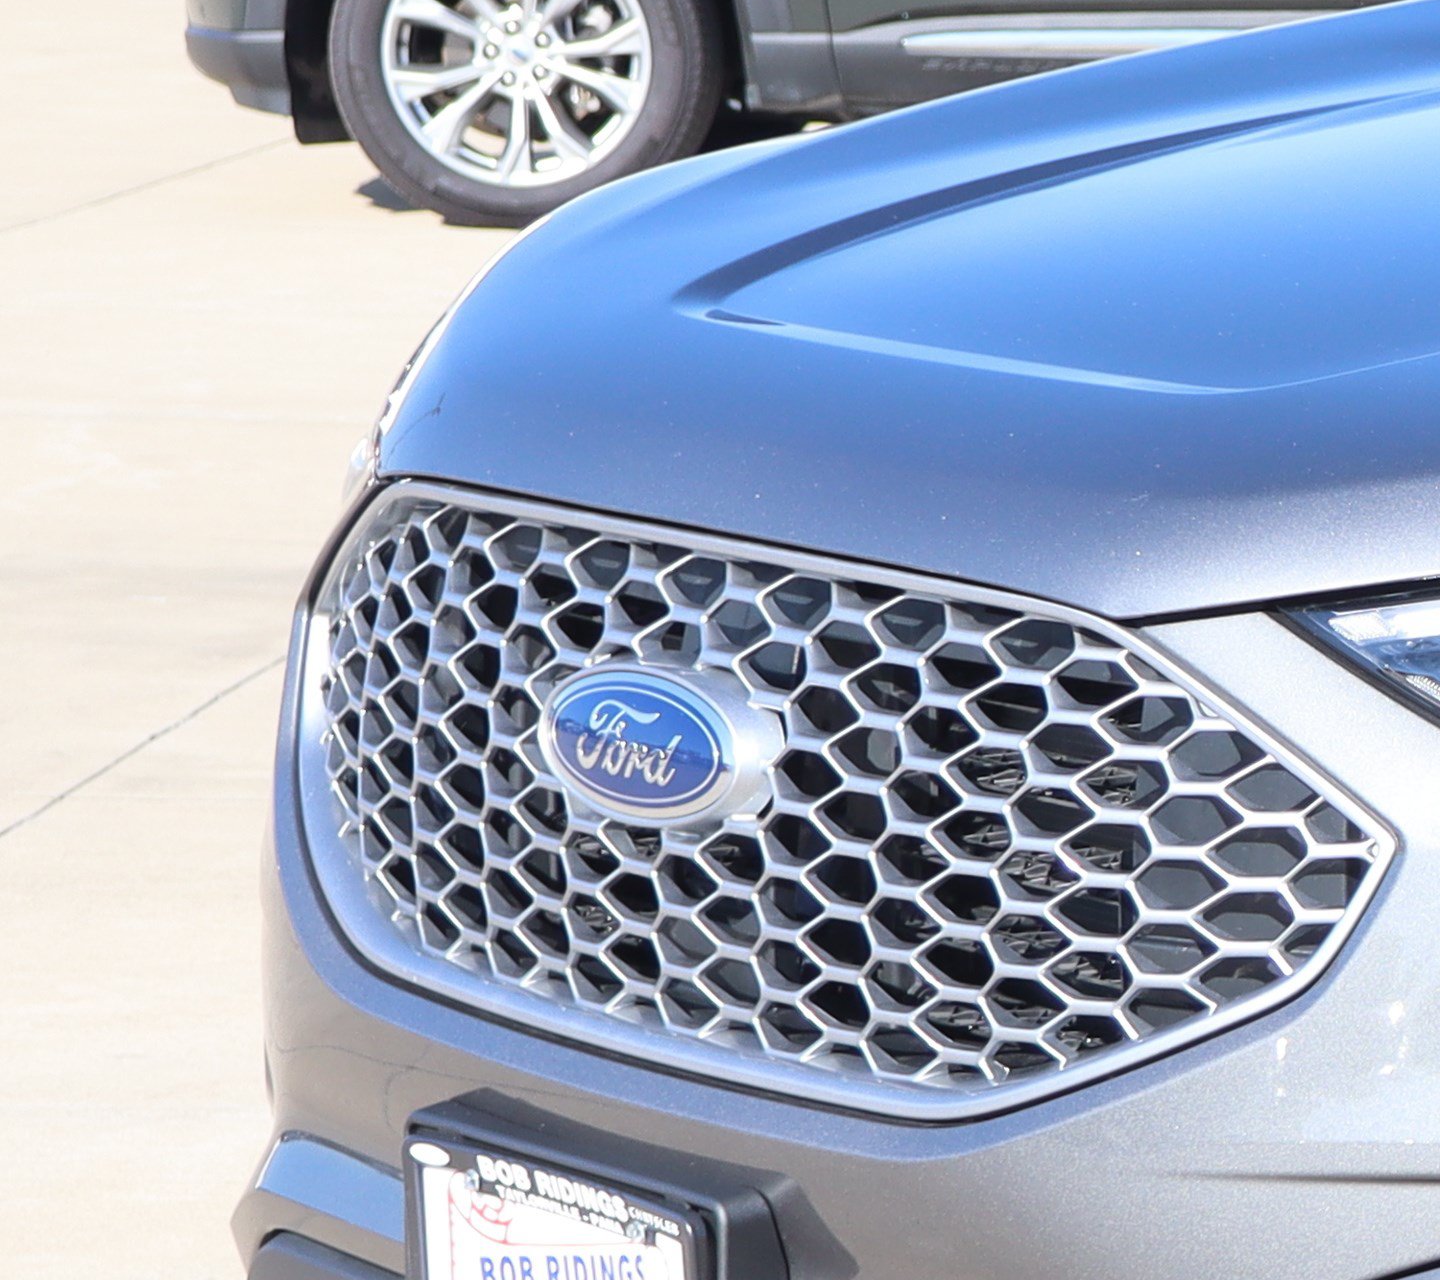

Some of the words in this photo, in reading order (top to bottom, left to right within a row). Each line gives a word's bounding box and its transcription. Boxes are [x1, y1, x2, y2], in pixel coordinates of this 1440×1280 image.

[576, 699, 683, 787] Ford
[476, 1153, 532, 1192] BOB
[533, 1170, 630, 1223] RIDINGS
